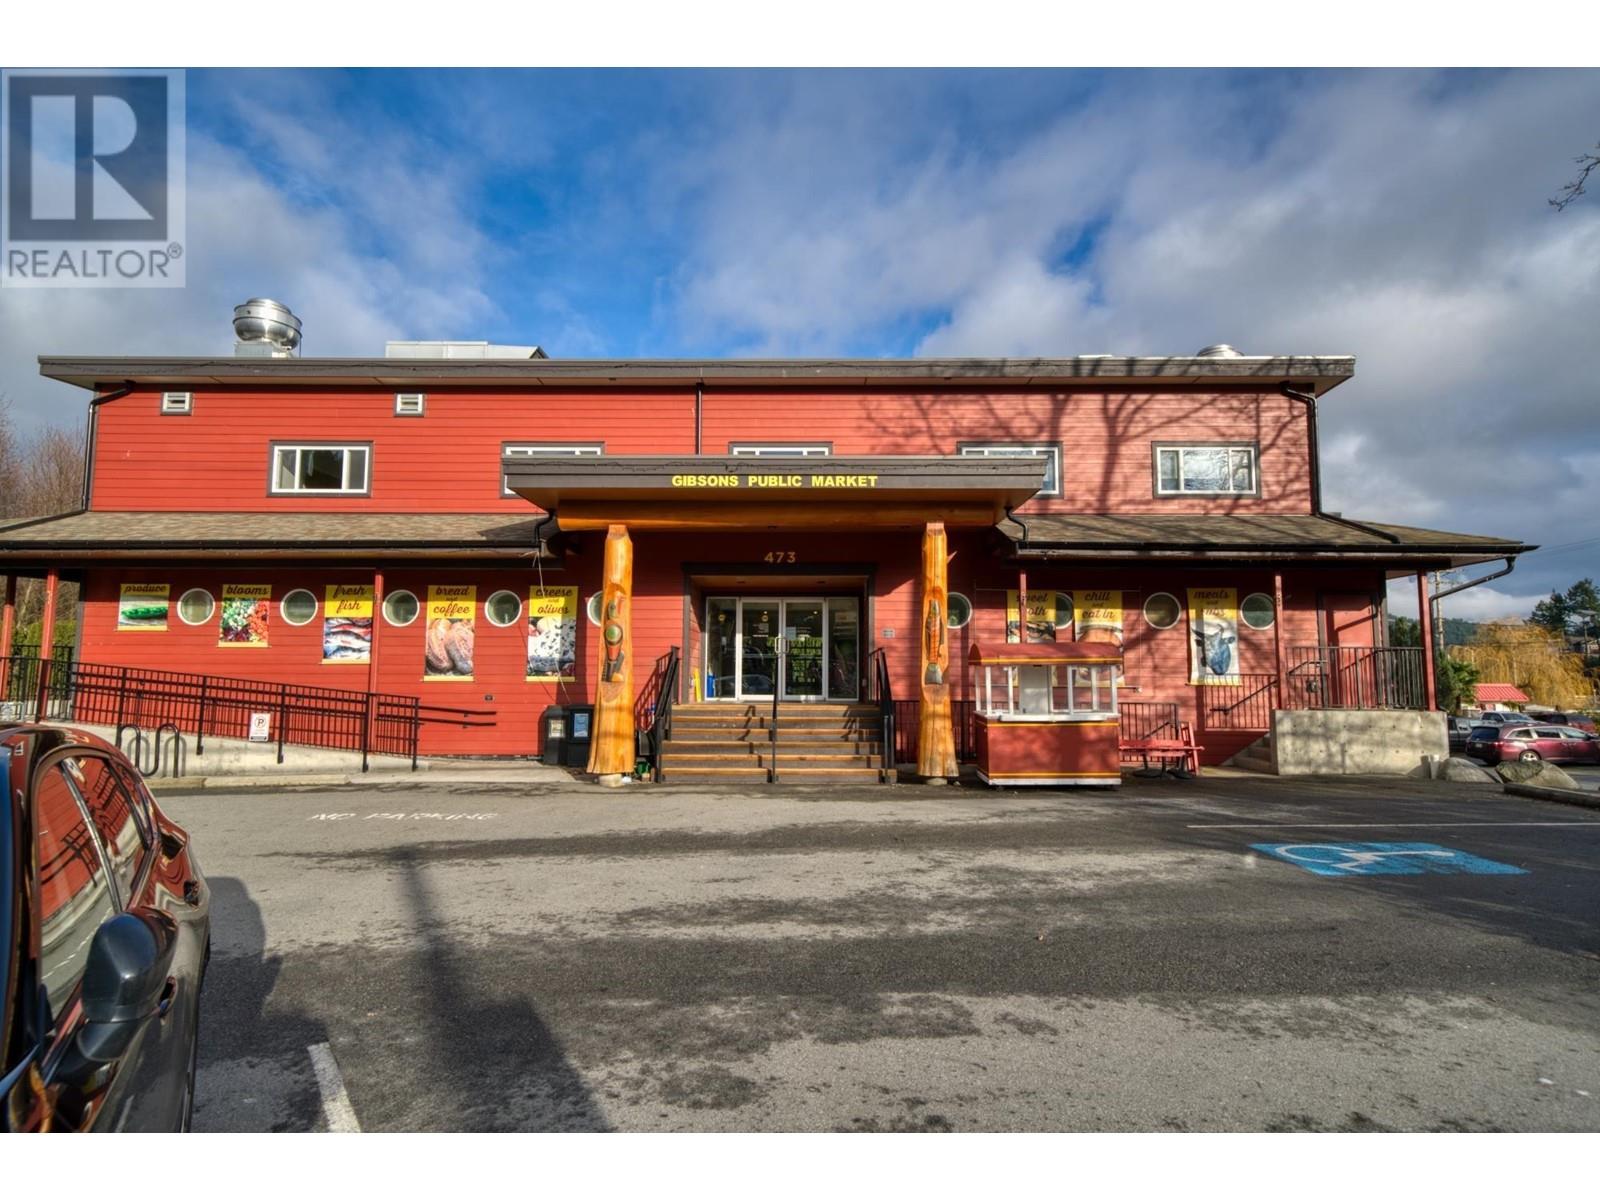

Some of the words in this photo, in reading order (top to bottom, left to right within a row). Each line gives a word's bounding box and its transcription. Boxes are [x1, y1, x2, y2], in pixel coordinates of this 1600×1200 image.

[671, 475, 739, 487] GIBSONS
[748, 475, 802, 487] PUBLIC
[811, 475, 878, 487] MARKET
[764, 552, 797, 564] 473
[124, 584, 167, 593] produce
[226, 584, 269, 595] blooms
[332, 585, 368, 599] fresh
[435, 586, 471, 596] bread
[535, 588, 573, 597] cheese
[1084, 591, 1112, 601] chill
[1192, 590, 1230, 599] meats
[336, 600, 362, 614] fish
[433, 602, 472, 617] coffee
[537, 604, 569, 615] olives
